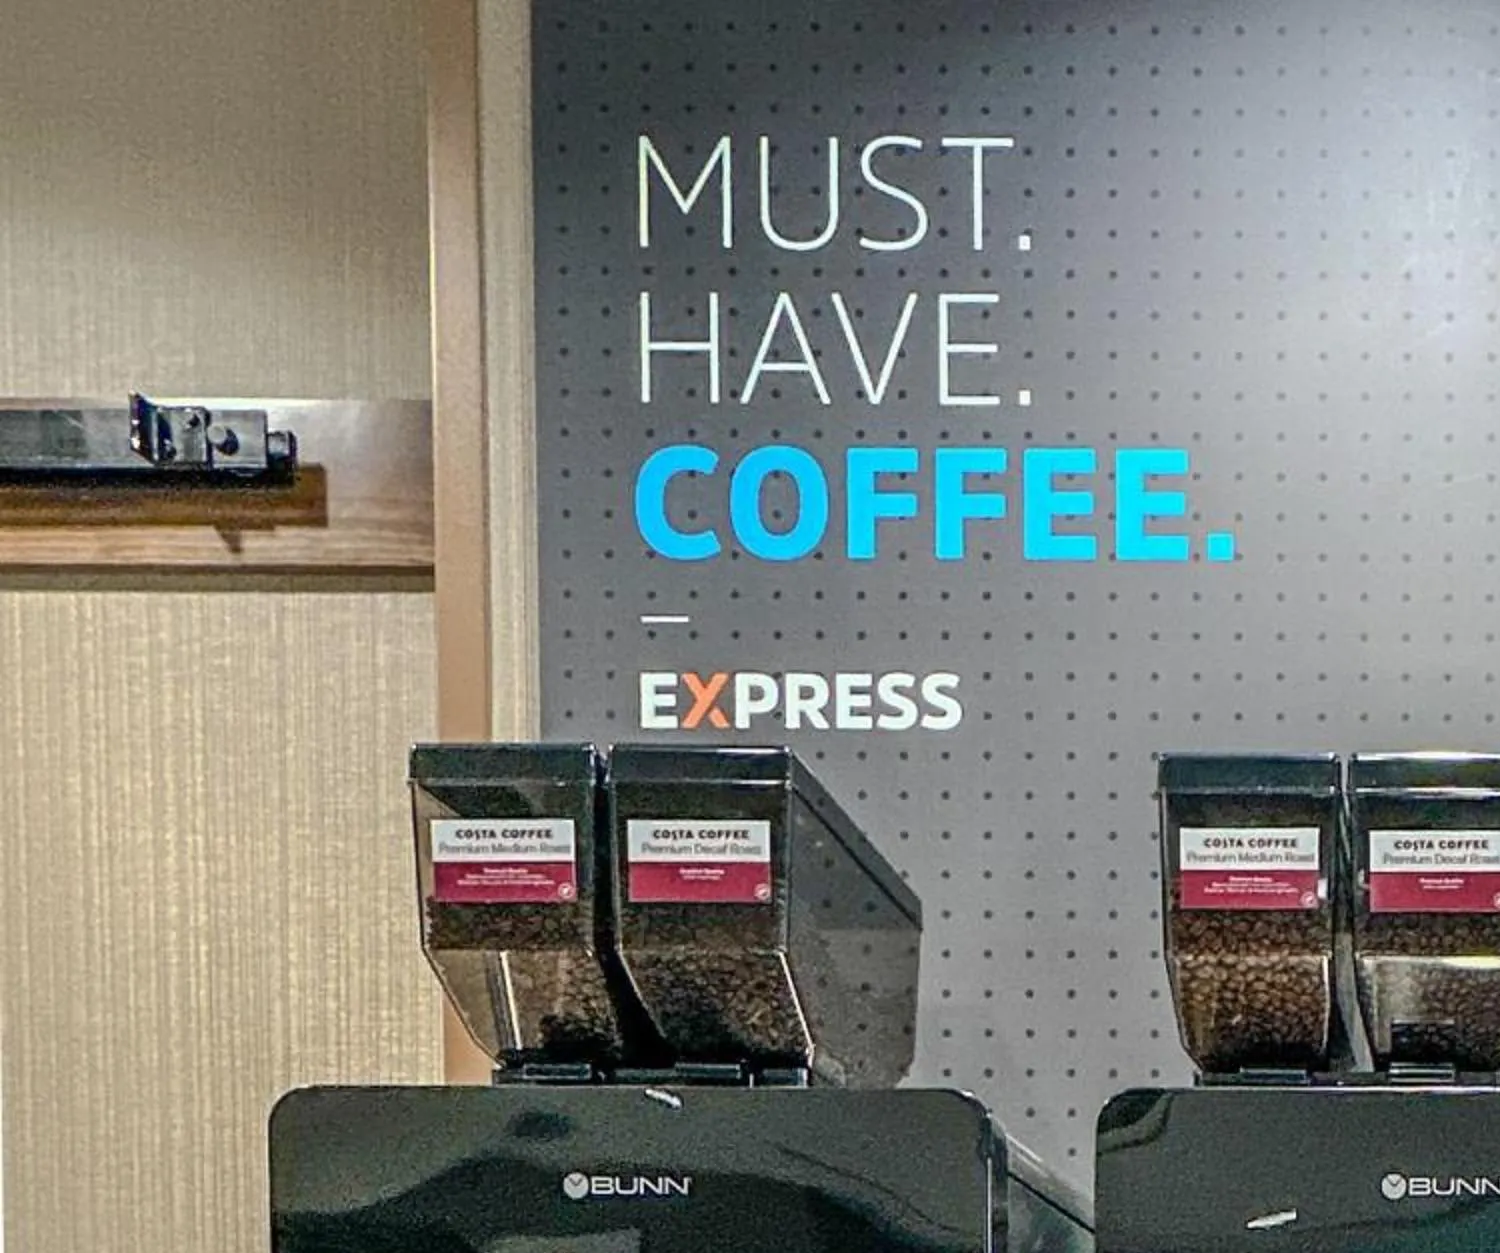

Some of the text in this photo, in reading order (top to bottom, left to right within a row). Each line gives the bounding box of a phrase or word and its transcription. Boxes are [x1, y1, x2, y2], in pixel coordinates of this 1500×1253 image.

[640, 136, 1031, 251] MUST.
[641, 292, 1031, 405] HAVE.
[634, 444, 1235, 561] COFFEE.
[639, 671, 963, 729] EXPRESS
[455, 829, 553, 840] COSTA COFFEE
[653, 829, 750, 840] COSTA COFFEE
[1203, 838, 1298, 848] COSTA COFFEE
[1394, 840, 1489, 851] COSTA COFFEE
[592, 1177, 691, 1196] BUNN
